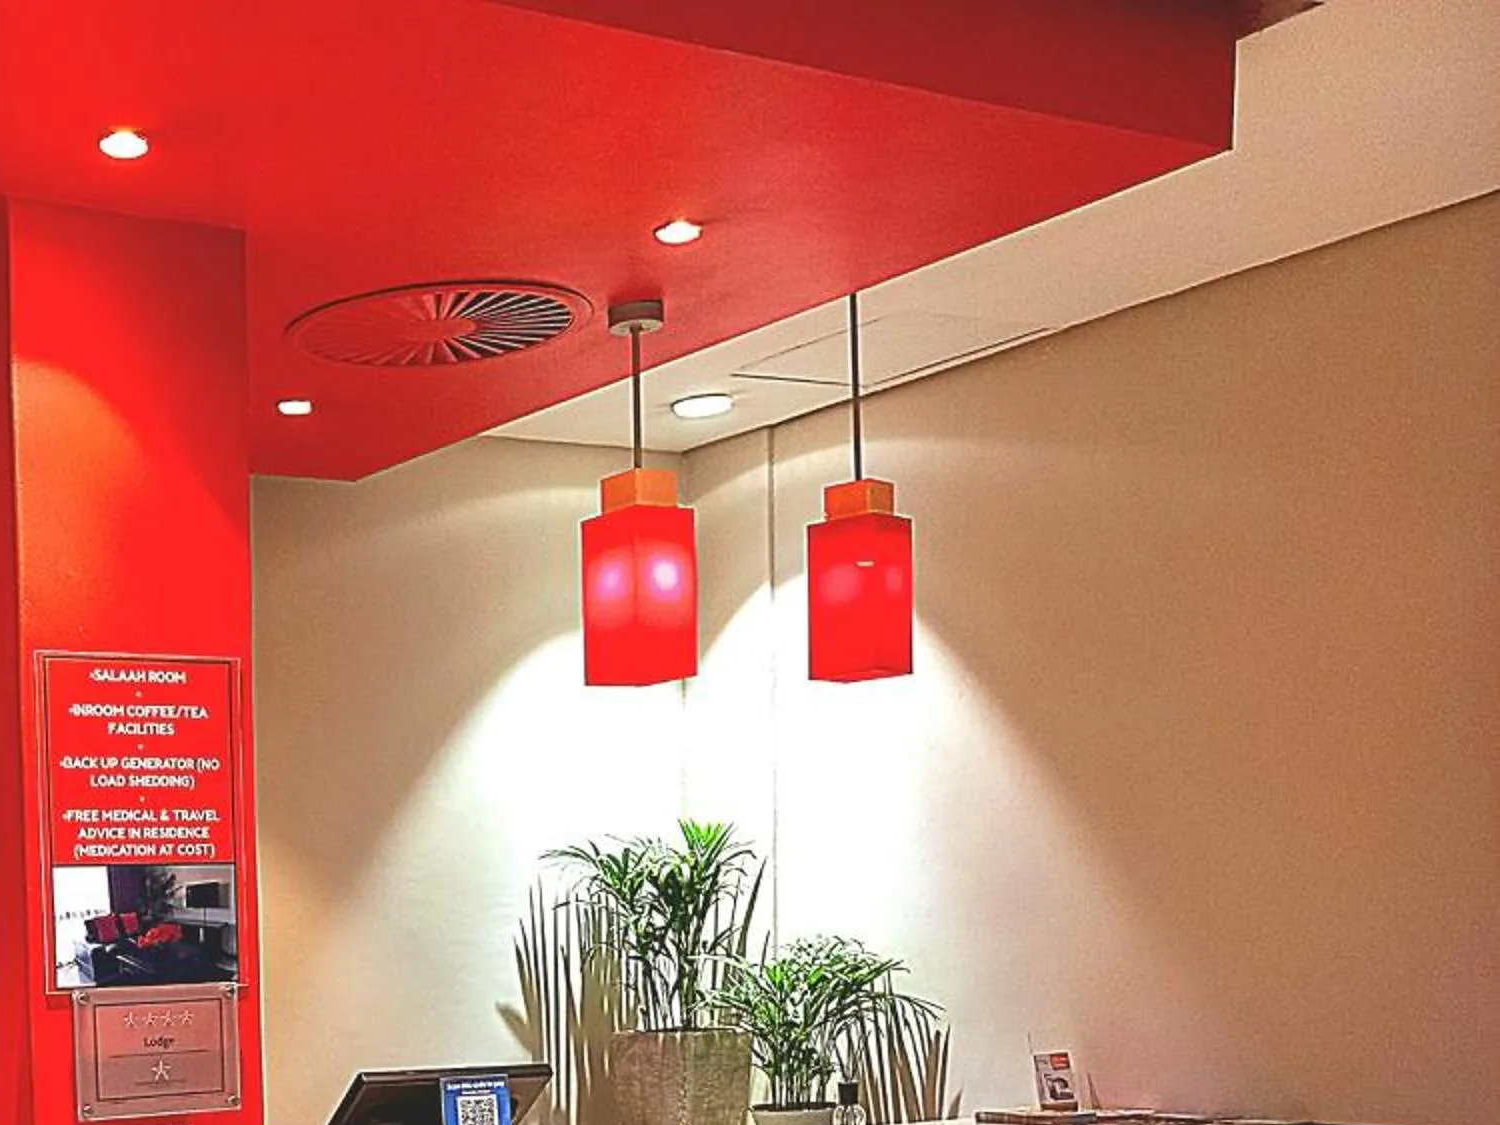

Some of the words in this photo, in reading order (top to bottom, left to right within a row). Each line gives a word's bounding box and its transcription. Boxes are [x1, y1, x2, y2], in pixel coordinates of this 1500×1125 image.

[93, 669, 146, 682] SALAAH
[148, 671, 187, 683] ROOM
[126, 705, 209, 719] COFFEE/TEA
[107, 722, 175, 736] FACILITIES
[100, 757, 118, 769] UP
[121, 757, 195, 771] GENERATOR
[197, 758, 220, 773] (NO
[89, 775, 126, 788] LOAD
[128, 775, 196, 790] SHEDDING)
[67, 809, 100, 822] FREE
[102, 809, 157, 822] MEDICAL
[160, 810, 169, 822] &
[173, 809, 220, 821] TRAVEL
[78, 827, 126, 839] ADVICE
[128, 827, 141, 839] IN
[143, 827, 210, 839] RESIDENCE
[74, 843, 155, 860] (MEDICATION
[159, 844, 175, 856] AT
[177, 844, 216, 859] COST)
